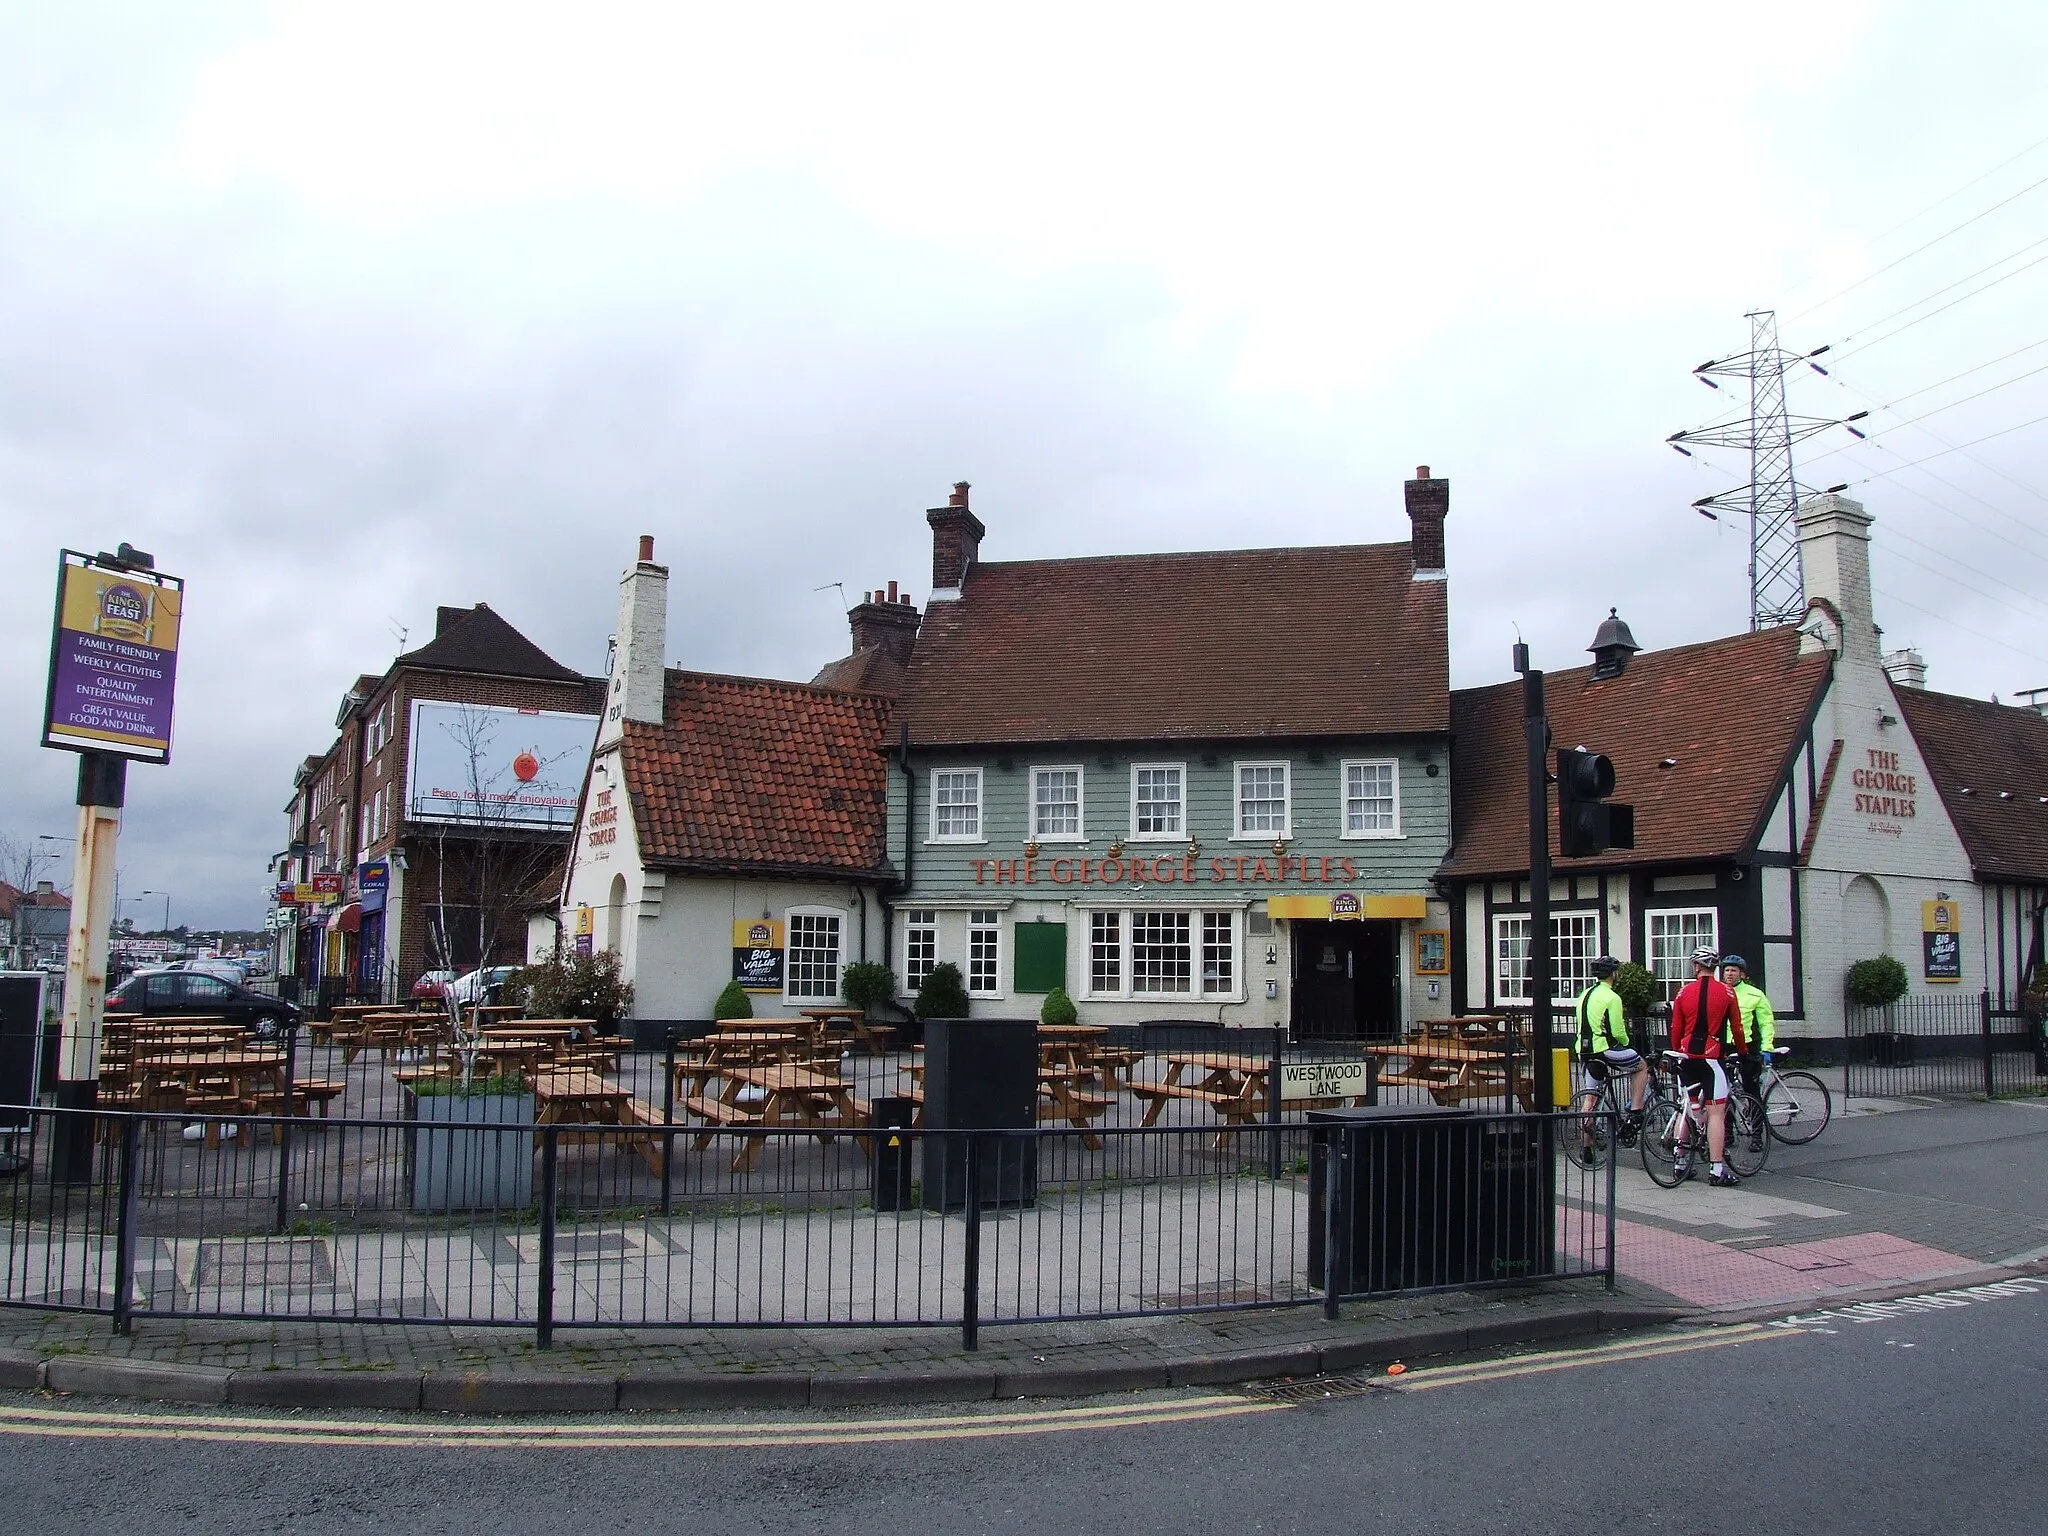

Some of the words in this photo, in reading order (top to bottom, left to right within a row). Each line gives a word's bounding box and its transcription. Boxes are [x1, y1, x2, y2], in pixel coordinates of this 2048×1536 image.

[108, 595, 141, 609] KINGS
[107, 604, 141, 620] FEAST
[79, 637, 114, 651] FAMILY
[116, 645, 160, 661] FRIENDLY
[74, 654, 112, 669] WEEKLY
[113, 663, 162, 679] ACTIVITIES
[97, 677, 137, 691] QUALITY
[76, 685, 155, 706] ENTERTAINMENT
[82, 704, 114, 717] GREAT
[115, 710, 147, 723] VALUE
[70, 713, 99, 725] FOOD
[101, 719, 123, 729] AND
[126, 722, 156, 734] DRINK
[1867, 748, 1899, 771] THE
[1853, 768, 1917, 794] GEORGE
[432, 788, 461, 799] Esso,
[520, 795, 568, 807] enjoyable
[597, 790, 612, 807] THE
[1855, 793, 1916, 817] STAPLES
[589, 827, 617, 847] STAPLES
[968, 857, 1038, 885] THE
[1050, 856, 1196, 884] GEORGE
[1210, 855, 1356, 883] STAPLES
[1935, 934, 1950, 945] BIG
[751, 949, 771, 961] BIG
[1931, 942, 1956, 957] VALUE
[743, 957, 777, 970] VALUE
[1286, 1065, 1362, 1081] WESTWOOD
[1309, 1081, 1341, 1096] LANE
[1503, 1258, 1532, 1268] recyce
